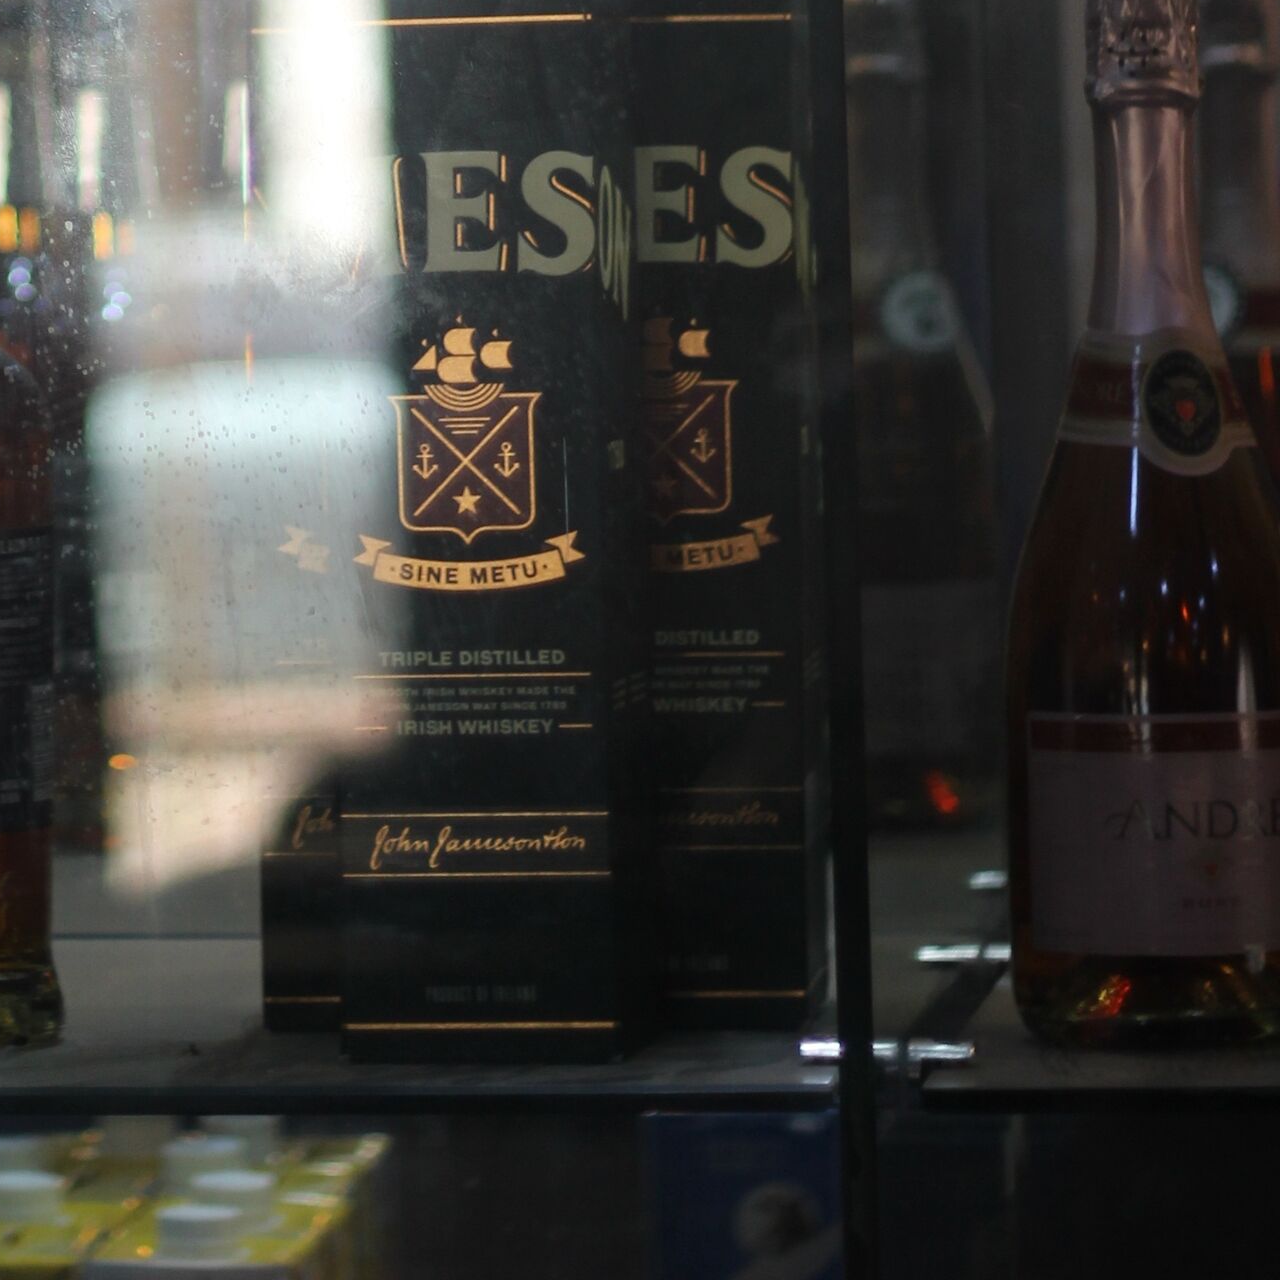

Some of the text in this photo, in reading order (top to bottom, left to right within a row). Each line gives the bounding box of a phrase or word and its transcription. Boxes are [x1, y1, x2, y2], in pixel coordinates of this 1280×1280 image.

[399, 560, 538, 586] SINE METU
[653, 629, 760, 646] DISTILLED
[379, 649, 565, 666] TRIPLE DISTILLED
[458, 686, 514, 696] WHISKEY
[516, 686, 549, 695] MADE
[553, 685, 577, 695] THE
[653, 697, 747, 713] WHISKEY
[397, 718, 554, 735] IRISH WHISKEY
[369, 824, 429, 871] John
